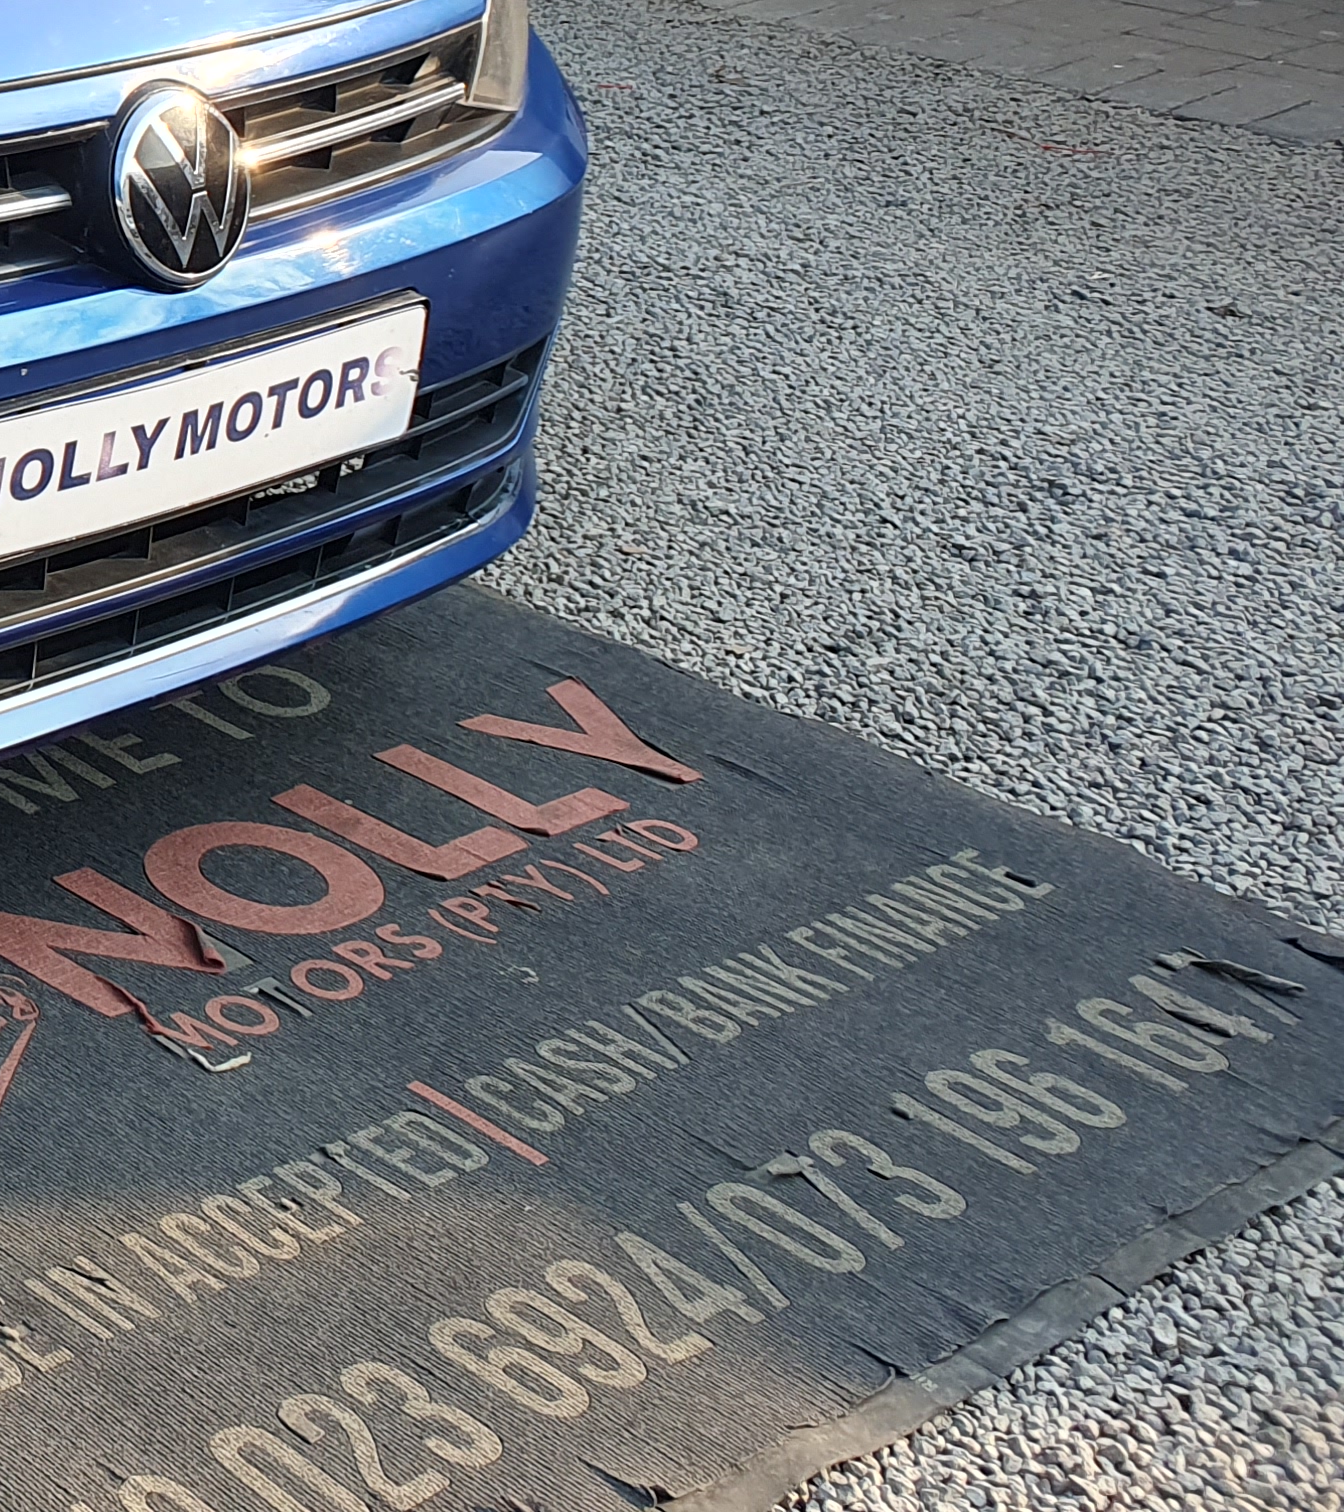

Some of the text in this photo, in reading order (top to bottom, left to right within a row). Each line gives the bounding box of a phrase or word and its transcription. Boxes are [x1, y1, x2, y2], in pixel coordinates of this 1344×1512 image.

[154, 663, 332, 740] TO
[140, 818, 701, 1059] MOTORS (PTY) LTD
[36, 1254, 162, 1341] IN
[120, 1108, 491, 1302] ACCEPTED
[465, 942, 850, 1132] CASH/BANK
[785, 846, 1055, 981] FINANCE
[428, 1127, 968, 1419] 6924/073
[892, 1050, 1126, 1175] 196
